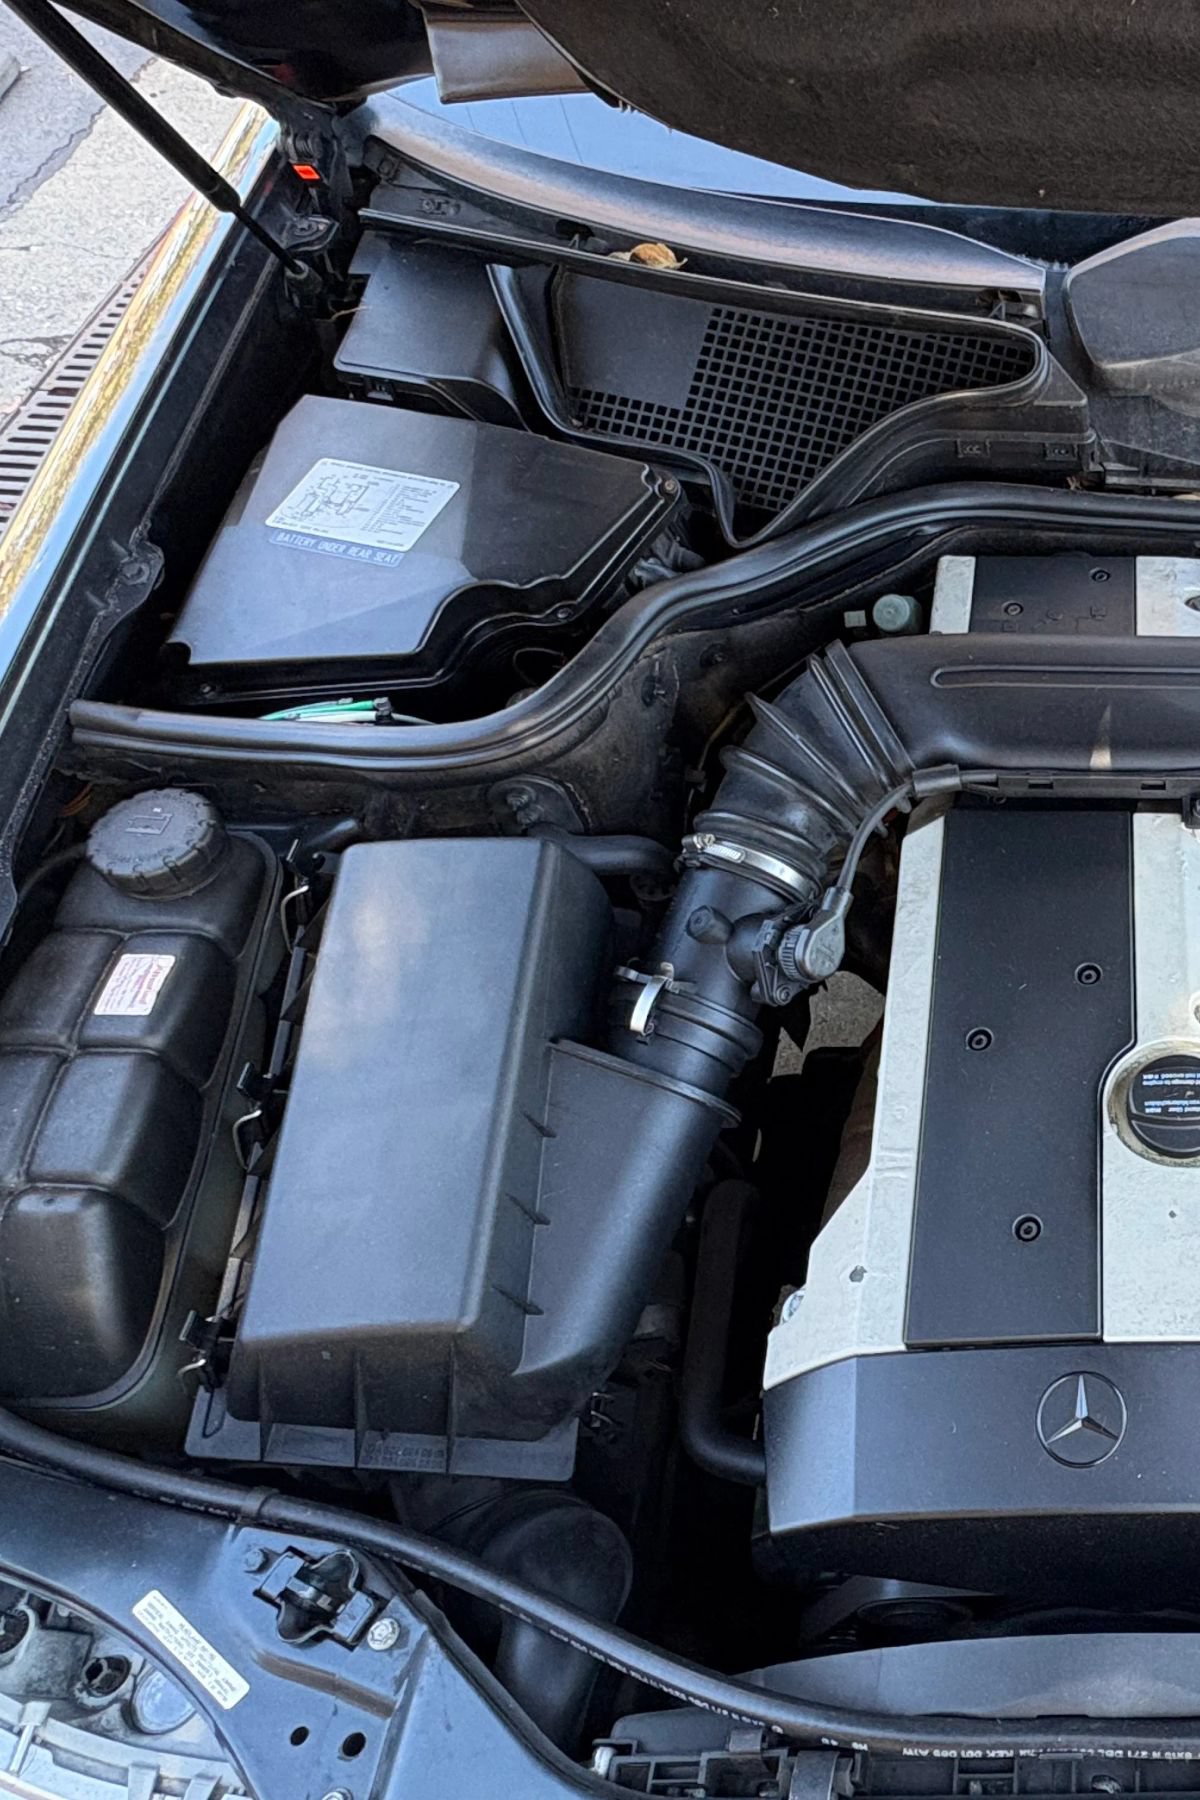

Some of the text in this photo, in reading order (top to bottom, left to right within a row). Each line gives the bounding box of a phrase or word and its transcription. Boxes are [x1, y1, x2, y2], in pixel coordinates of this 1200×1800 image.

[277, 532, 399, 563] BATTERY UNDER REAR SEAT
